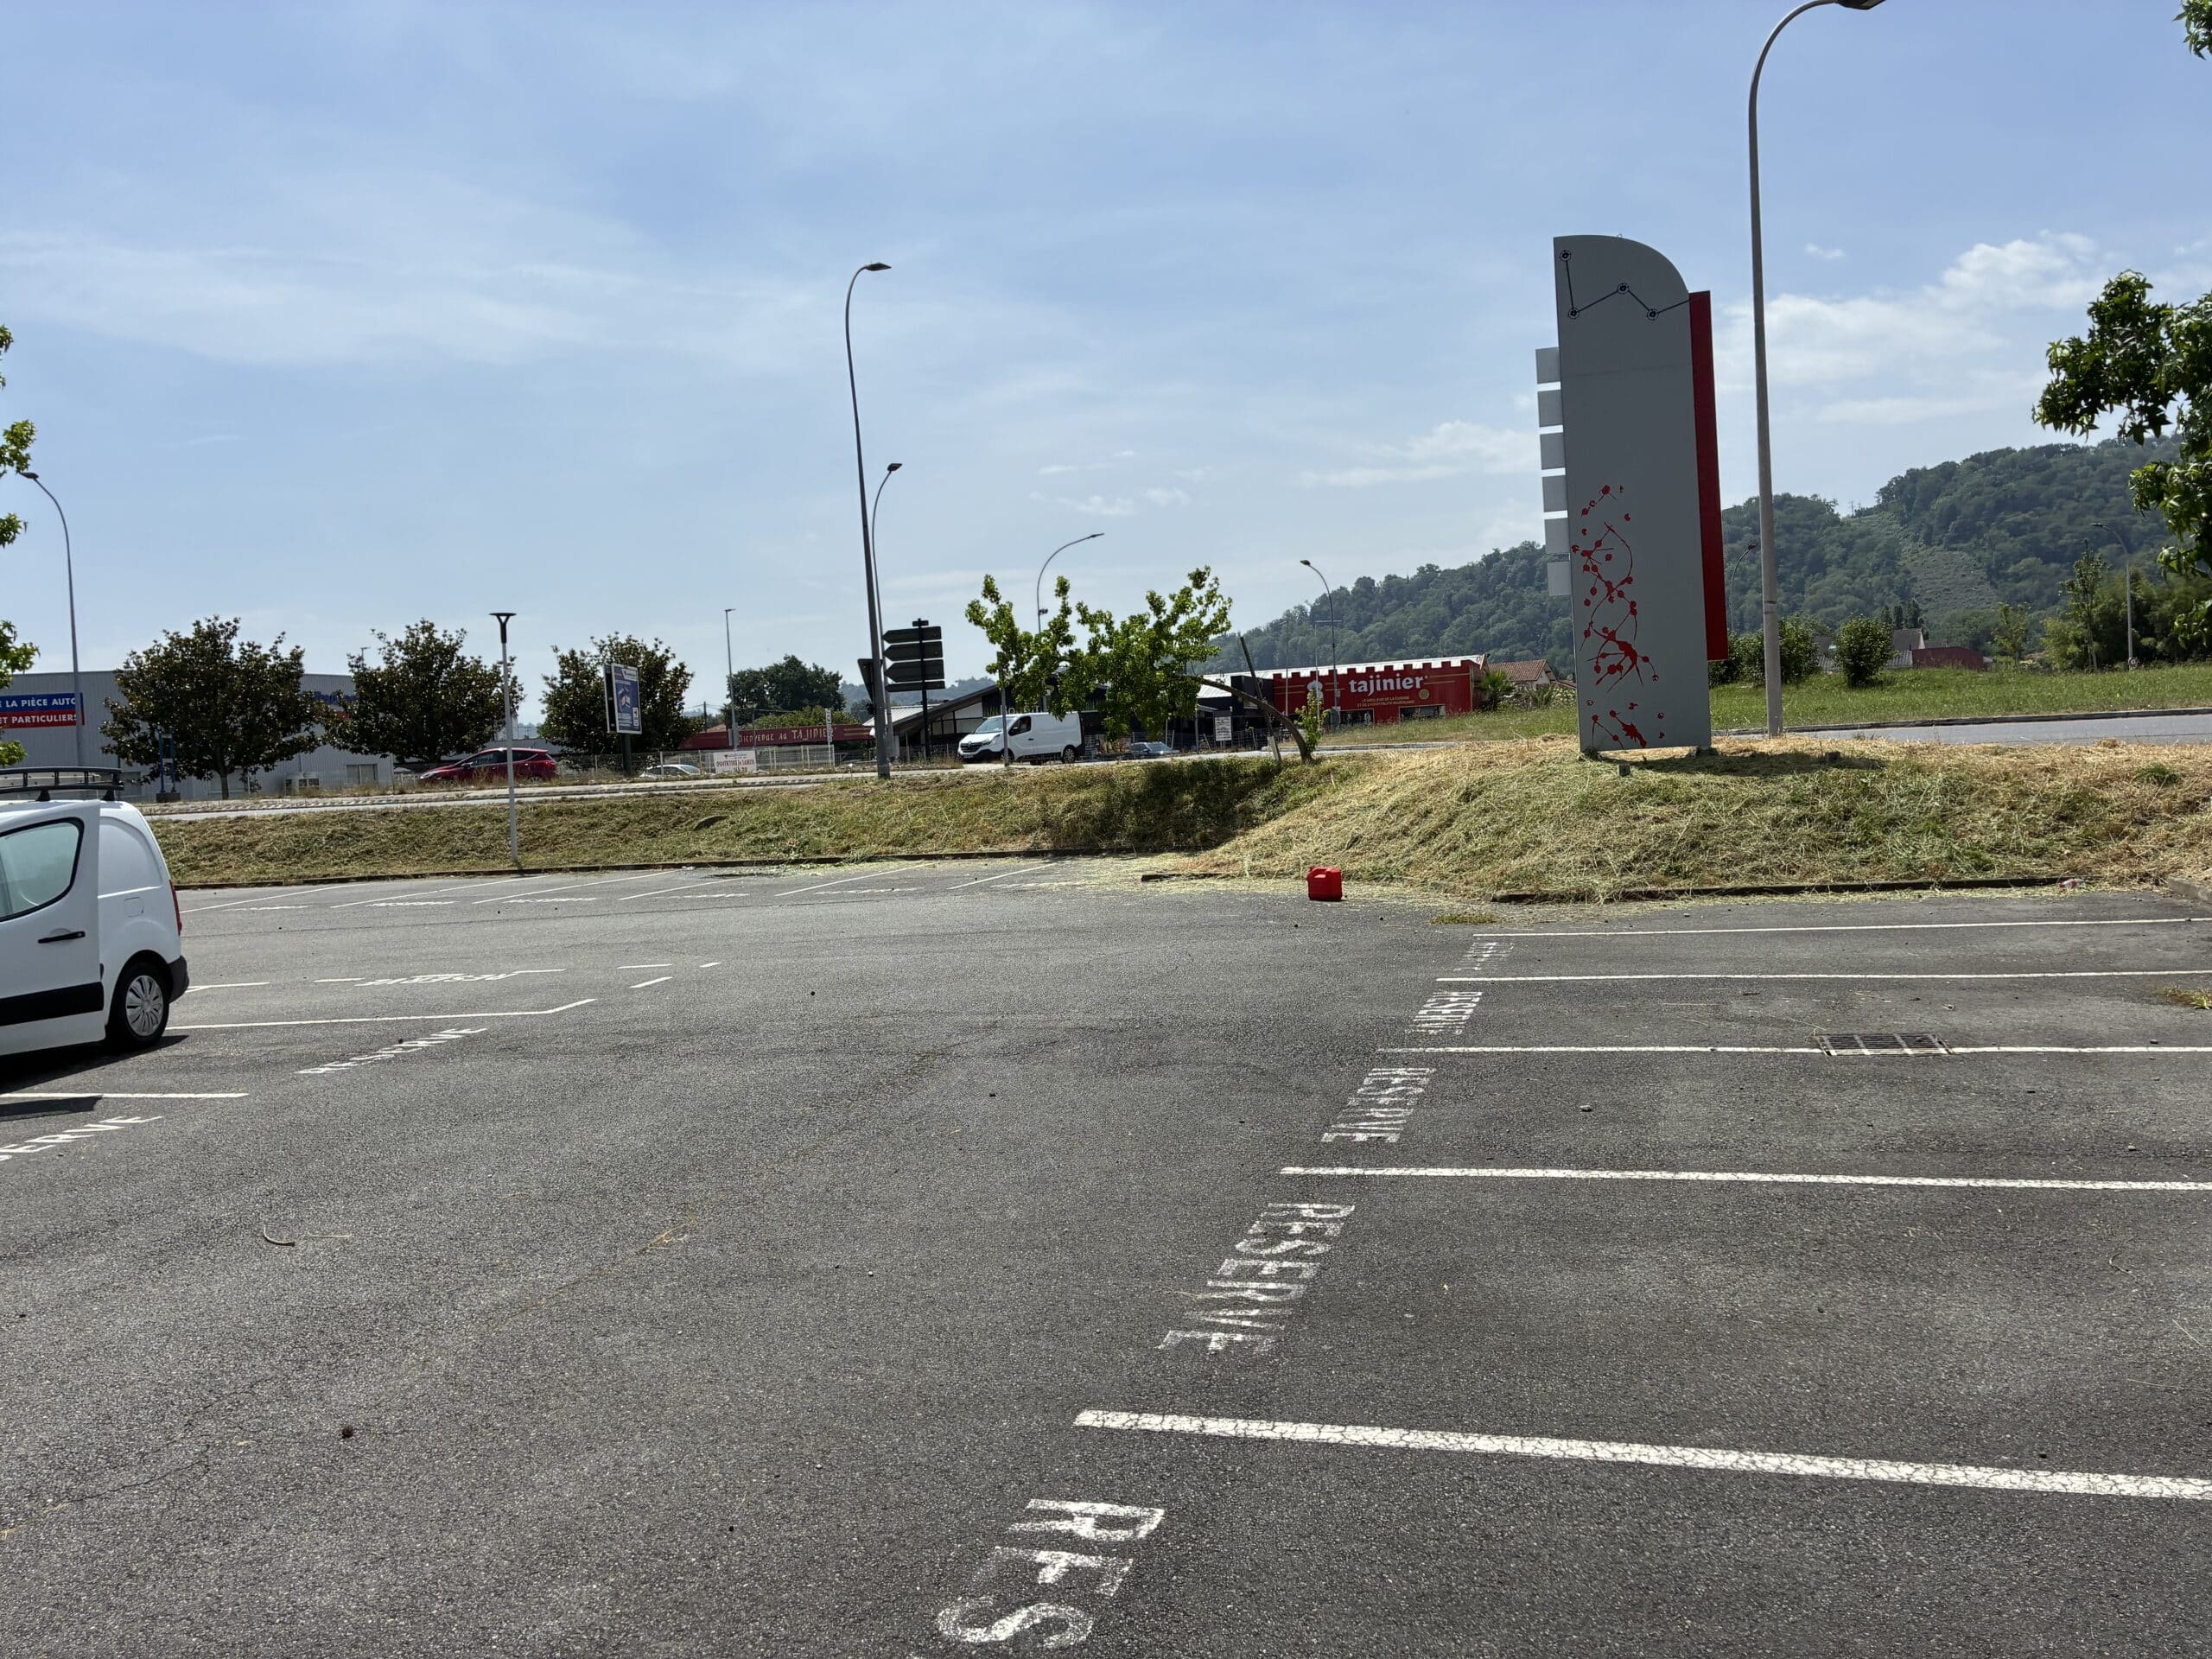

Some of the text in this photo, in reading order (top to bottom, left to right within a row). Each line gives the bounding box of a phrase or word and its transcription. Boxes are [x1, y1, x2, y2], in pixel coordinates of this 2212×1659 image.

[21, 696, 48, 707] PIÈCE
[1349, 673, 1423, 696] tajinier
[11, 714, 77, 724] PARTICULIERS
[294, 1028, 487, 1074] RESERVE
[1321, 1068, 1437, 1143] RESERVE
[0, 1116, 163, 1161] ERVE
[1156, 1203, 1355, 1354] RESERVE
